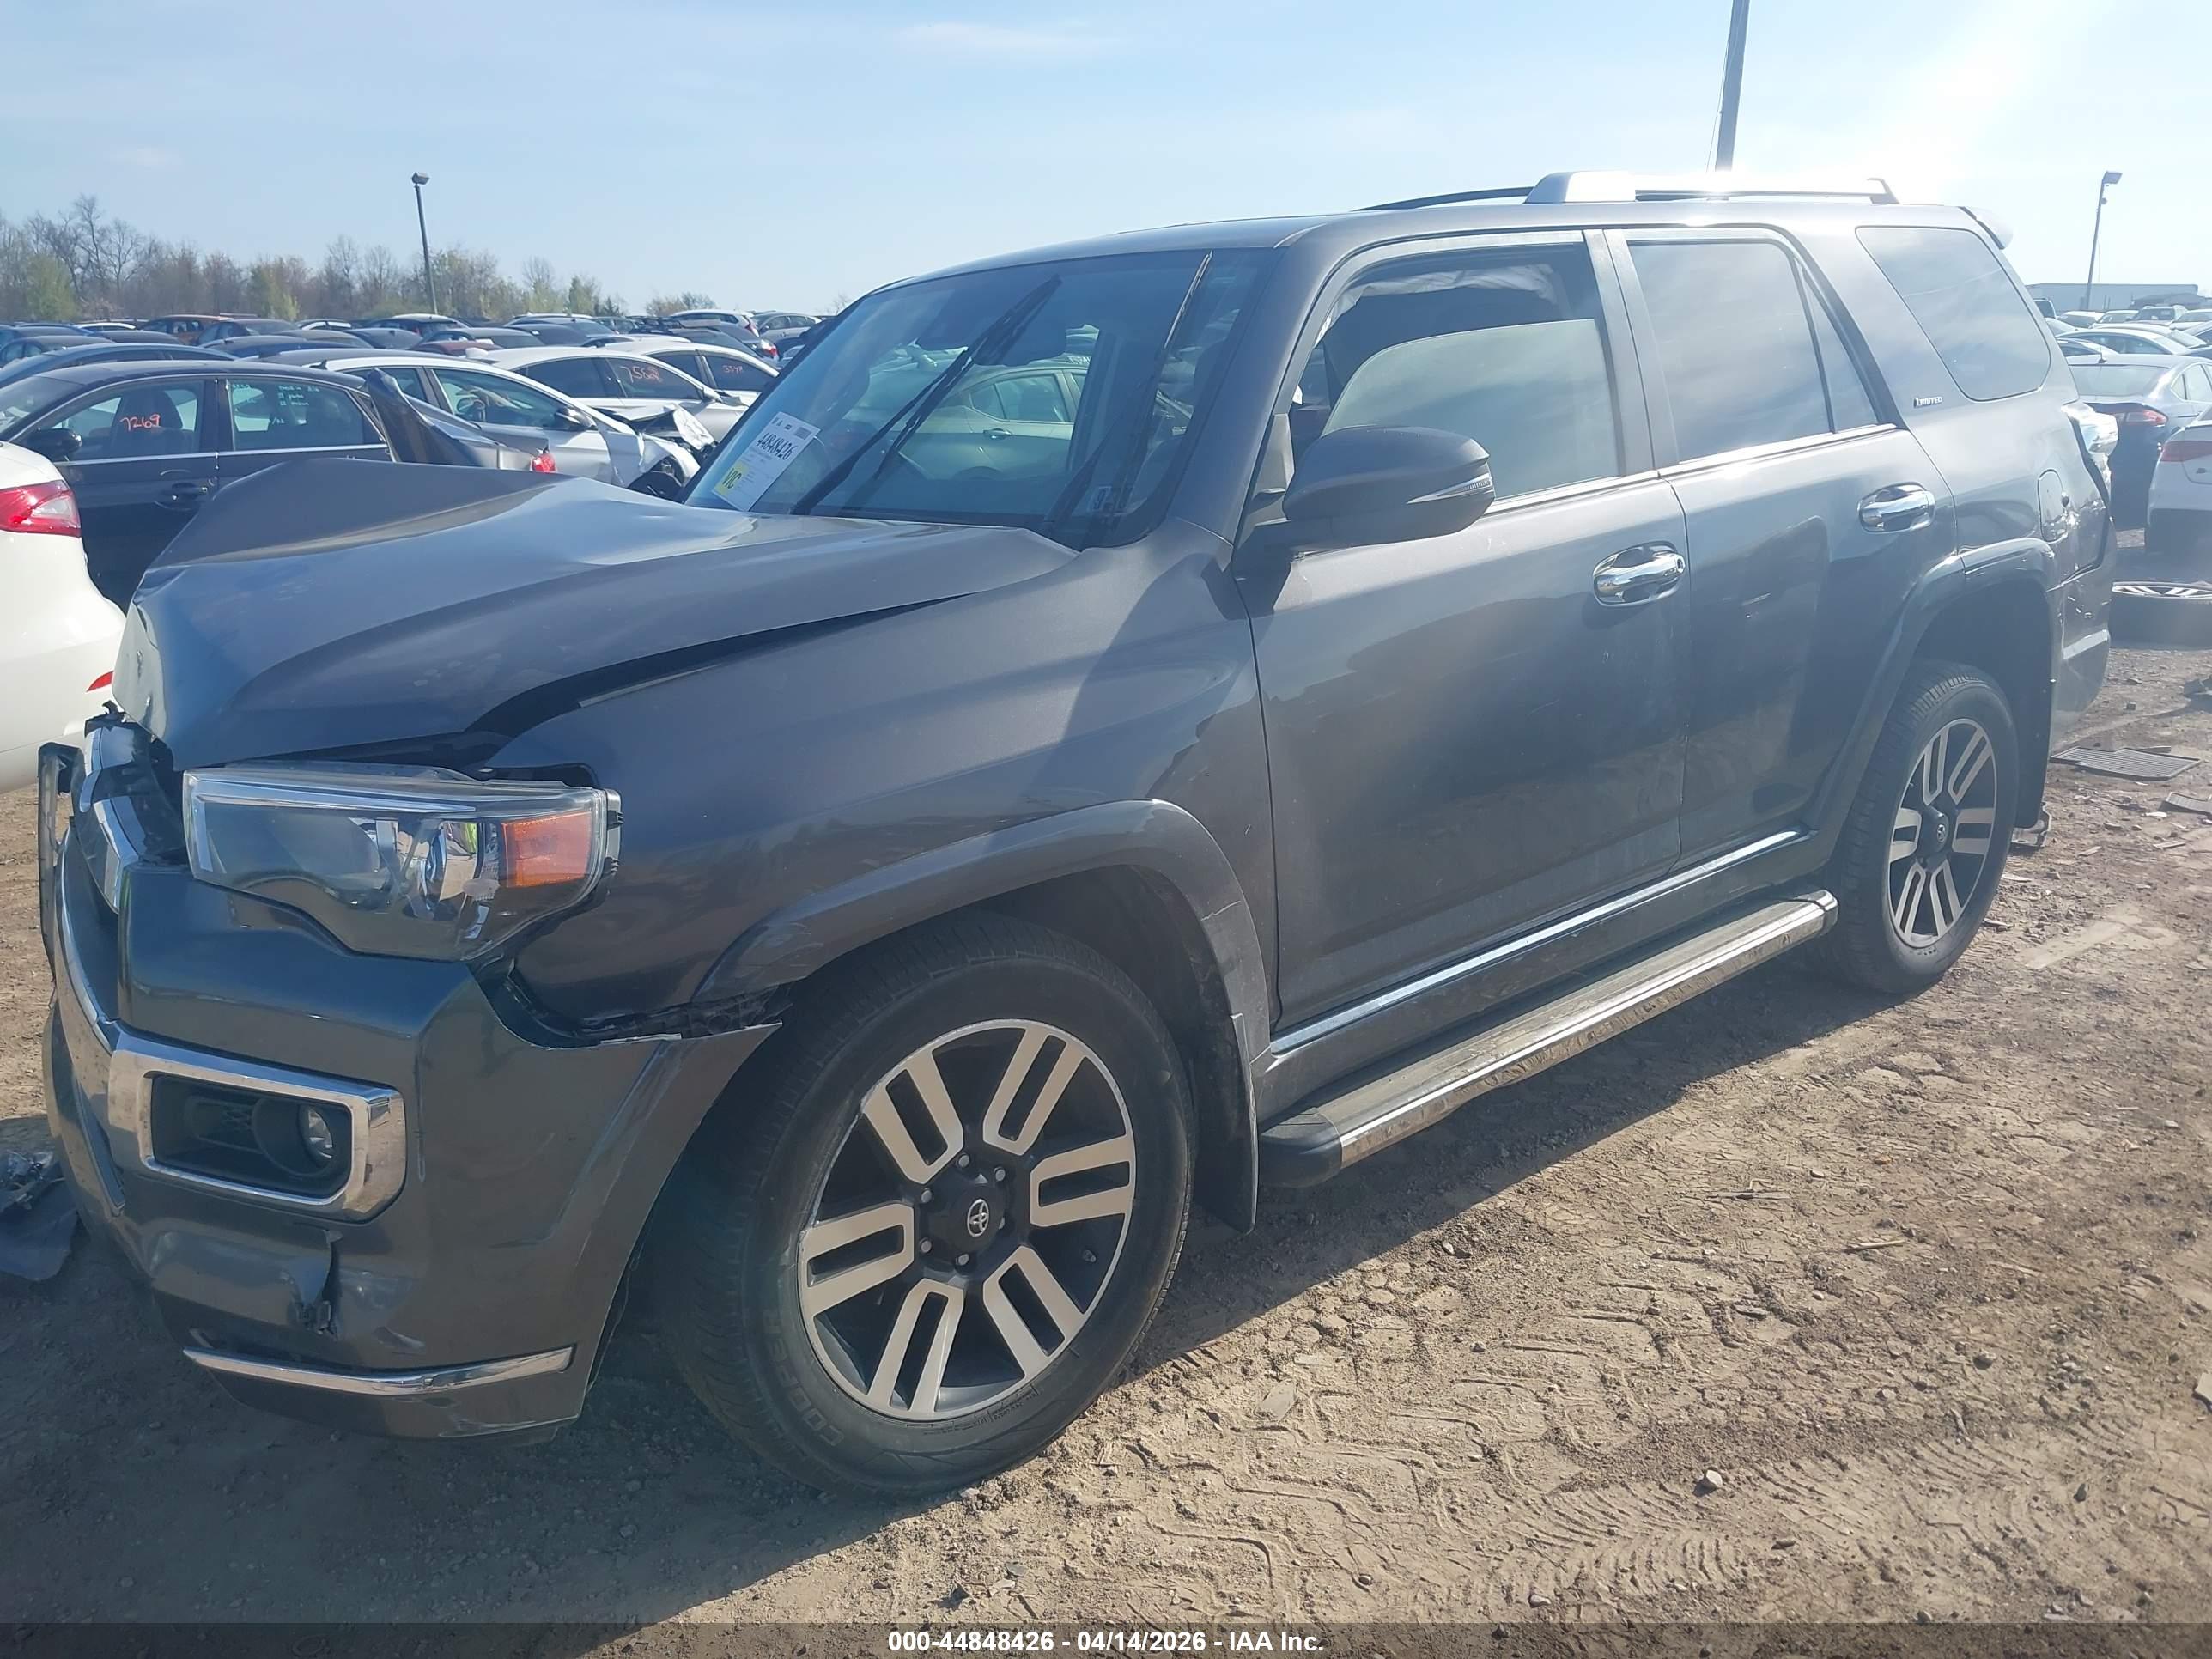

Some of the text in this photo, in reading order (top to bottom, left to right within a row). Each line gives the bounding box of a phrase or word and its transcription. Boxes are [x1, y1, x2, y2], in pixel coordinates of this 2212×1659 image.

[119, 413, 161, 433] 7269
[757, 432, 798, 461] 44848426
[722, 468, 743, 489] VIC
